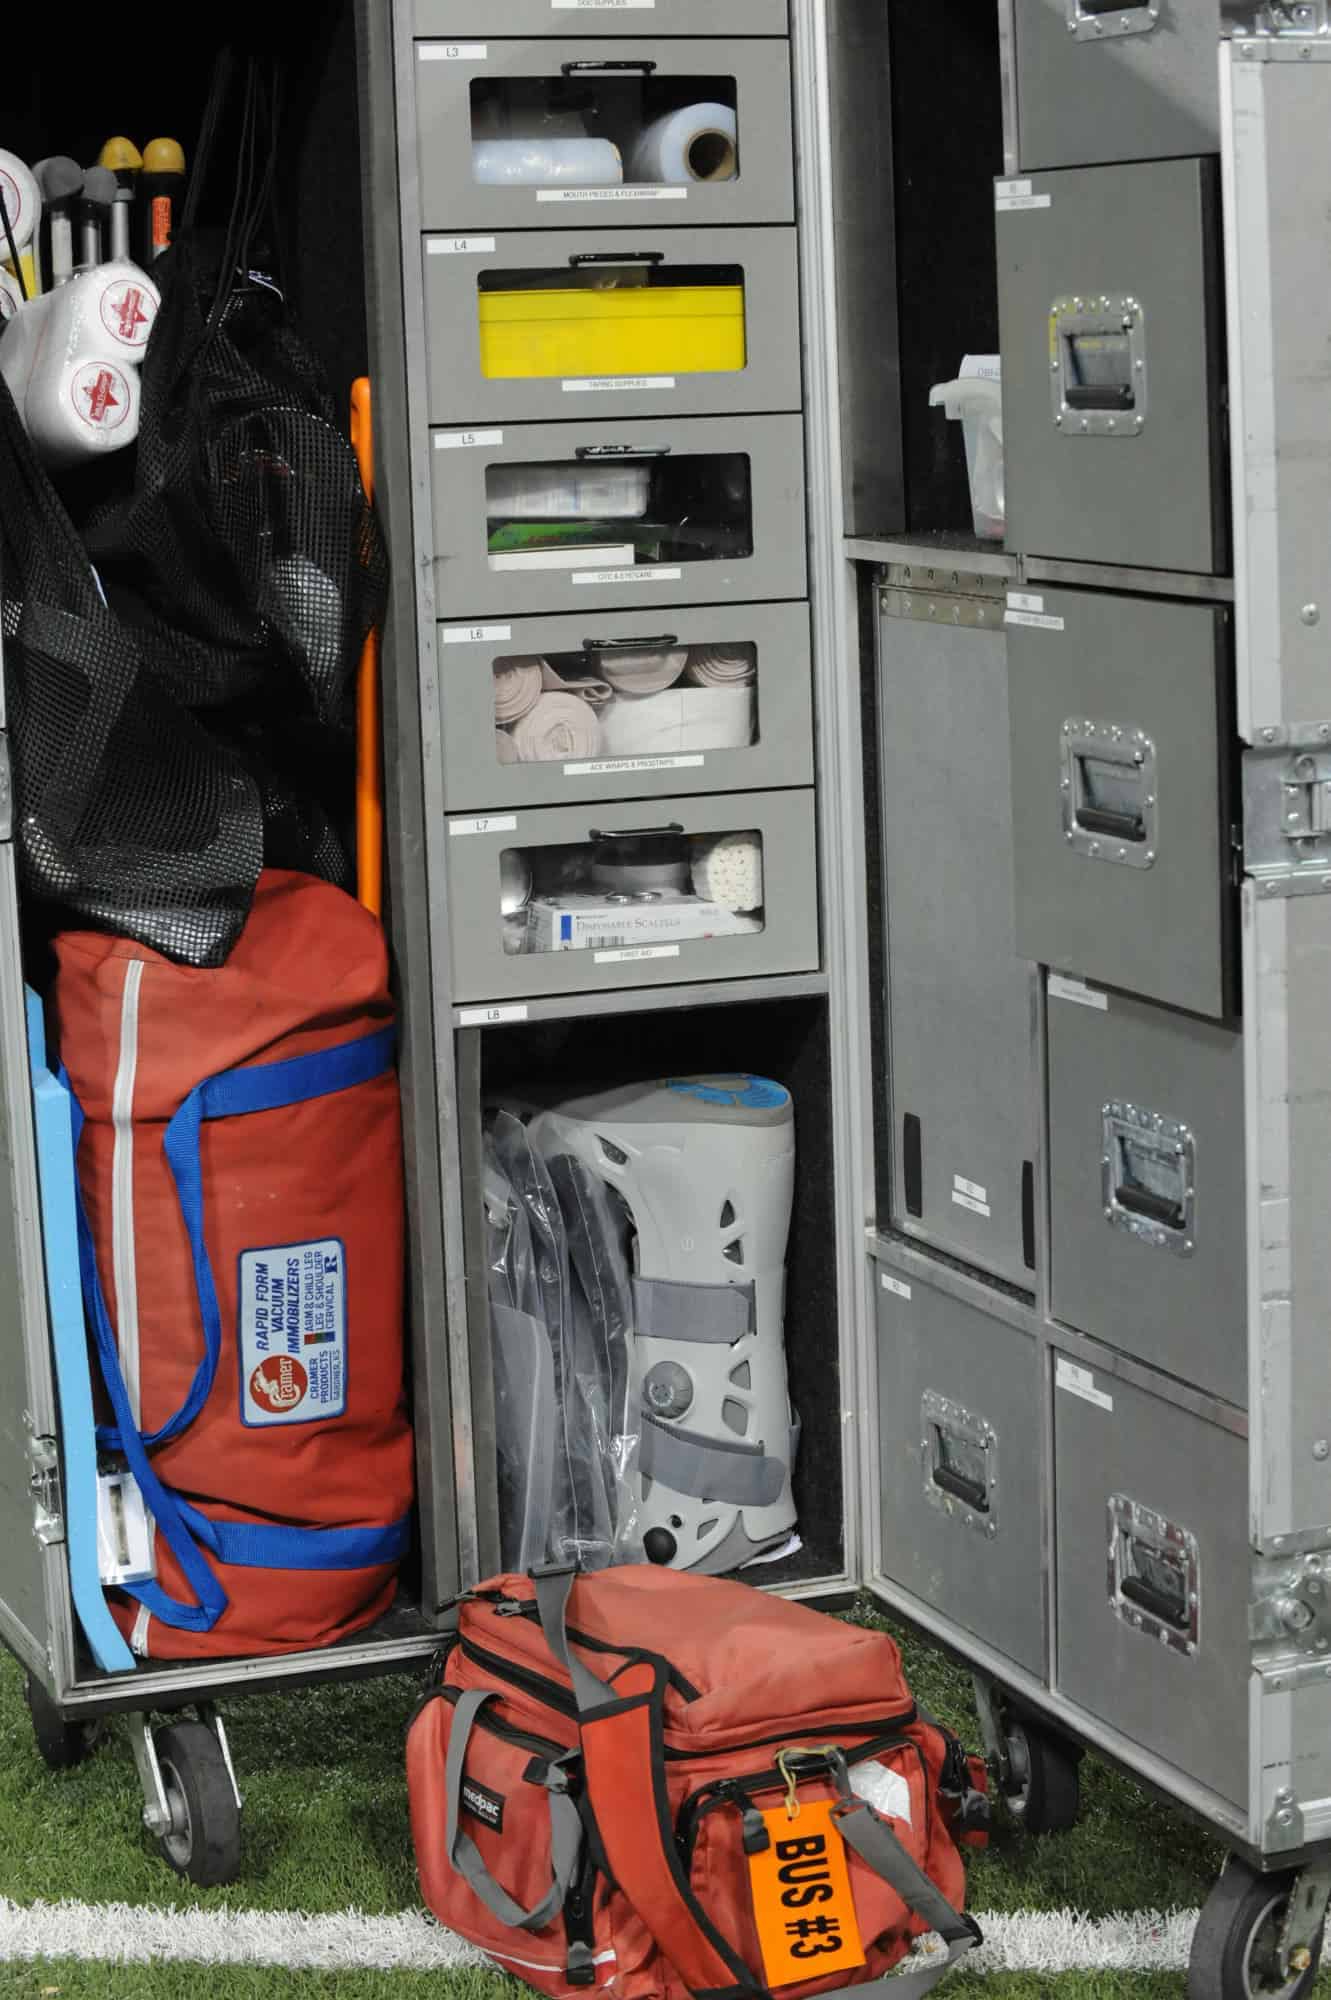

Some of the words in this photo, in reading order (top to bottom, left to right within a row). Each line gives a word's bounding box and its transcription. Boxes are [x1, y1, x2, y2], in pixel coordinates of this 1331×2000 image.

[447, 47, 459, 57] L3
[563, 191, 587, 199] MOUTH
[454, 239, 467, 250] L4
[462, 433, 475, 445] L5
[470, 629, 483, 641] L6
[476, 820, 489, 832] L7
[487, 1009, 500, 1021] L8
[303, 1251, 313, 1270] LEG
[256, 1262, 269, 1302] FORM
[304, 1273, 313, 1301] CHILD
[314, 1251, 324, 1301] SHOULDER
[271, 1278, 284, 1333] VACUUM
[287, 1258, 300, 1354] IMMOBILIZERS
[325, 1282, 335, 1329] CERVICAL
[256, 1307, 269, 1351] RAPID
[304, 1310, 313, 1331] ARM
[315, 1312, 324, 1331] LEG
[309, 1358, 319, 1400] CRAMER
[319, 1350, 329, 1404] PRODUCTS
[776, 1834, 833, 1908] BUS
[785, 1915, 843, 1959] #3
